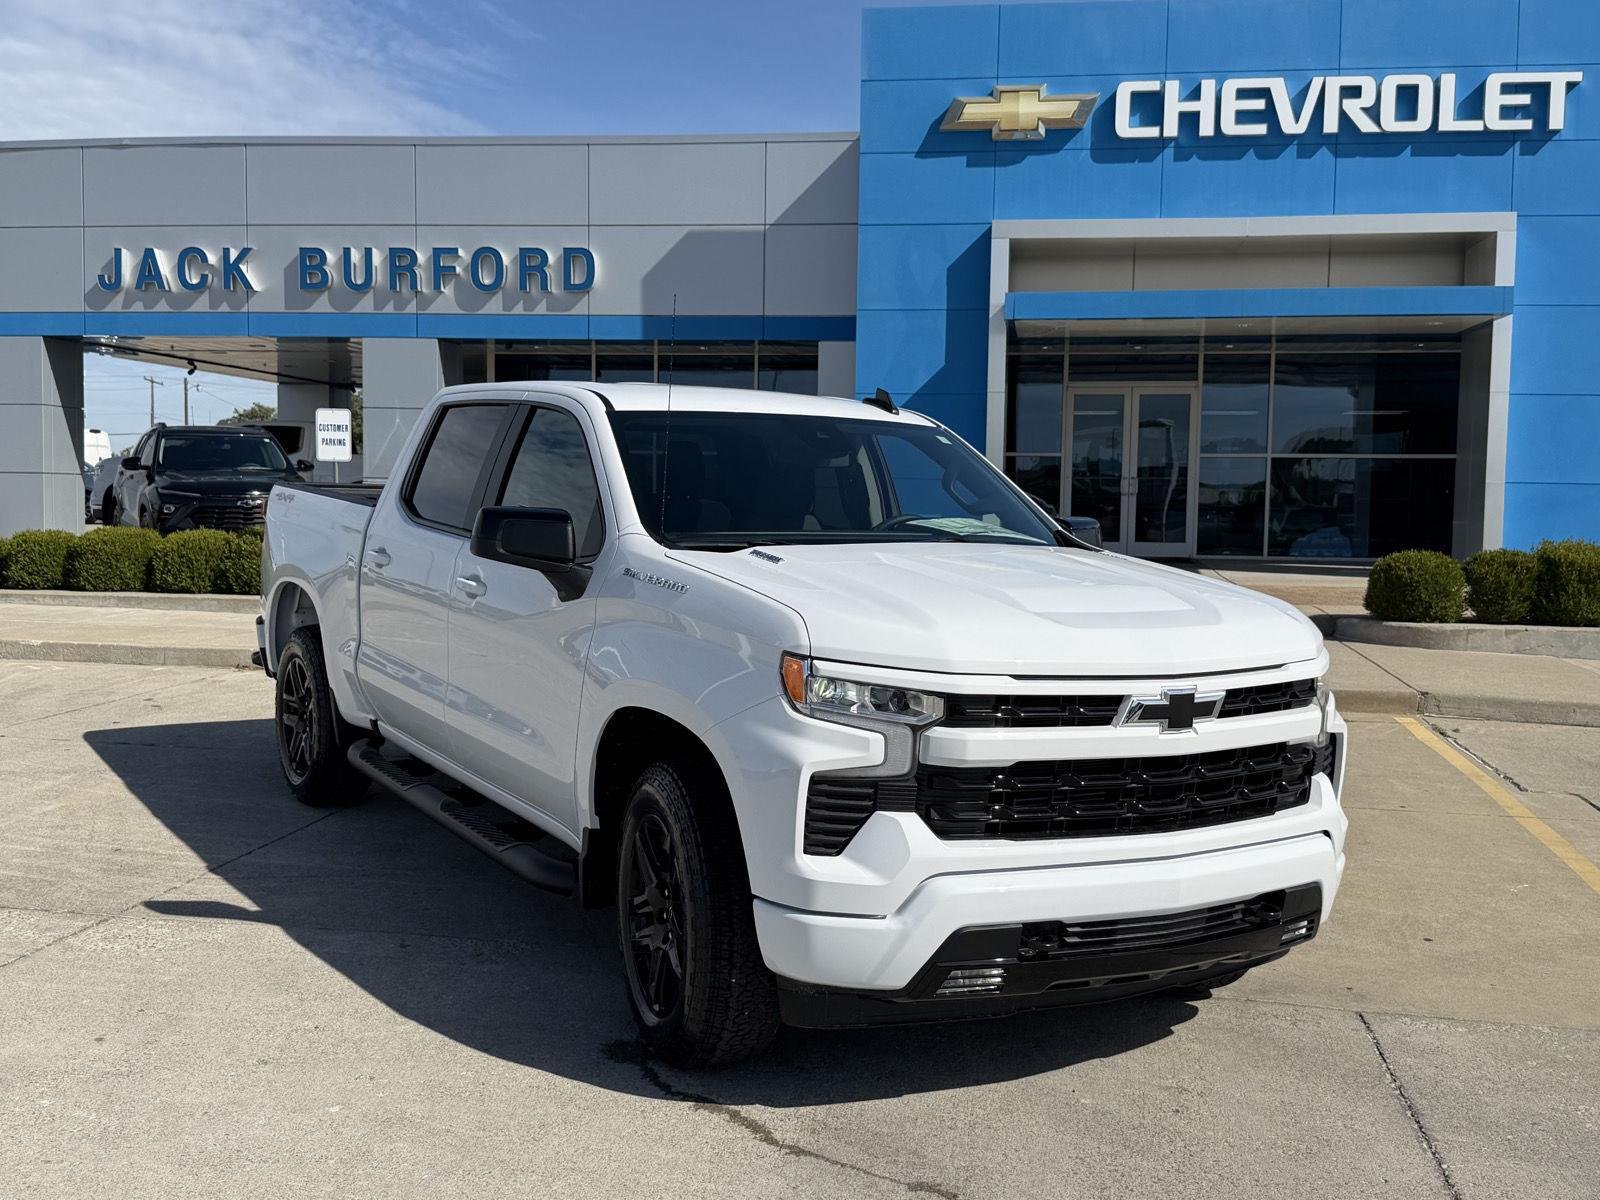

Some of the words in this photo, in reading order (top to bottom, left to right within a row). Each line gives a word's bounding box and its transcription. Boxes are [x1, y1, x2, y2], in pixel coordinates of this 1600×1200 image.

[1114, 71, 1584, 139] CHEVROLET
[97, 246, 258, 293] JACK
[298, 246, 597, 293] BURFORD
[319, 423, 349, 432] CUSTOMER
[321, 438, 346, 447] PARKING
